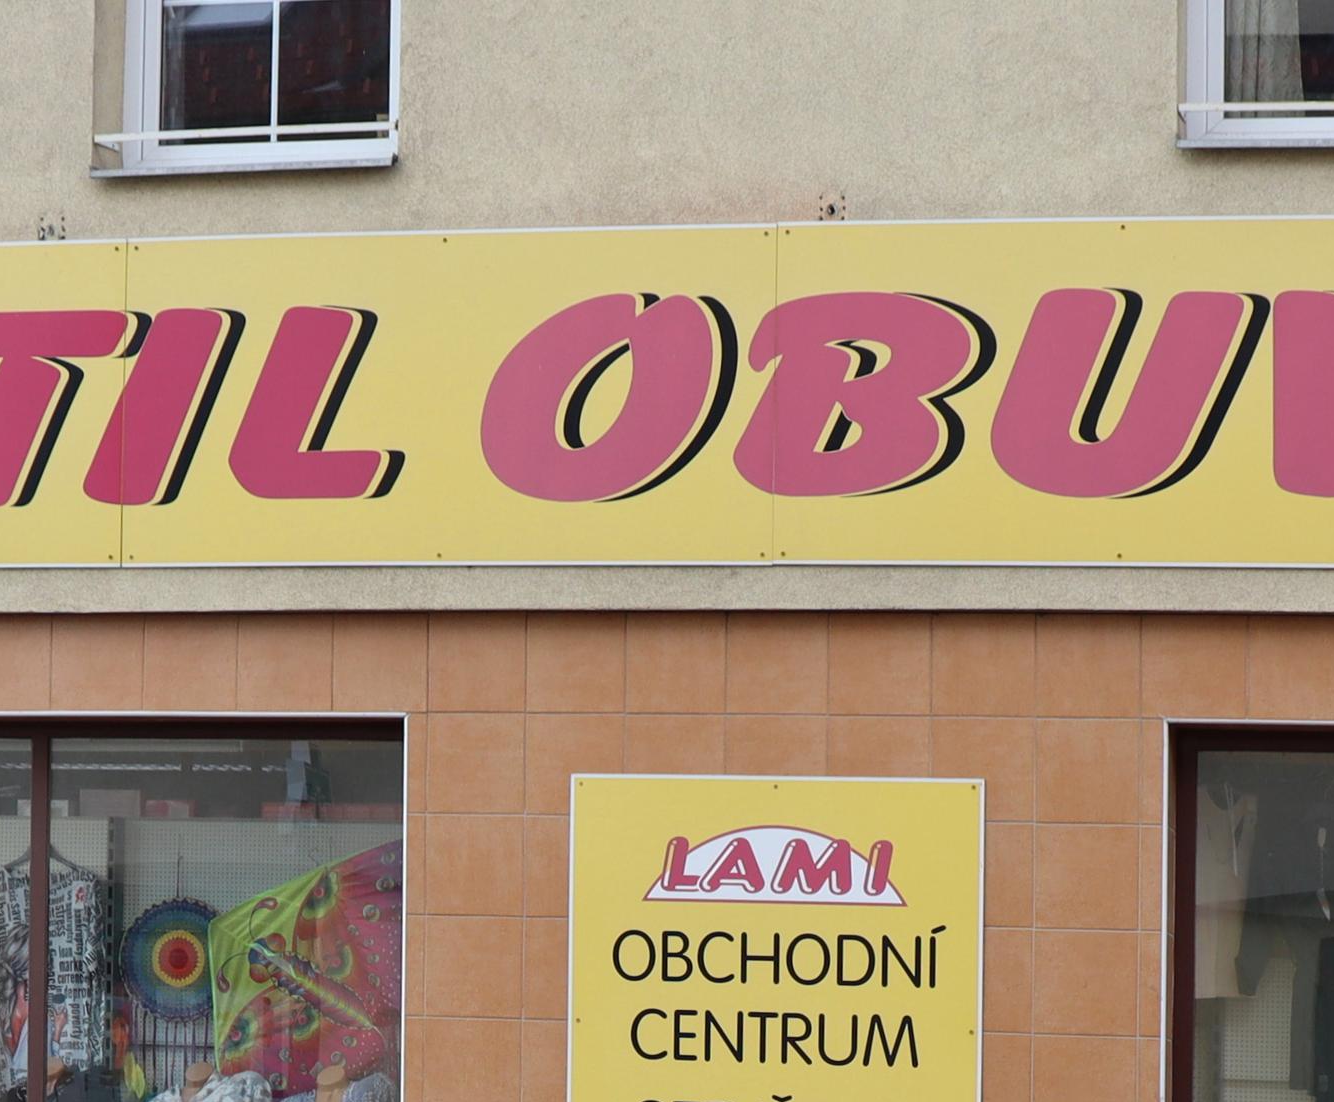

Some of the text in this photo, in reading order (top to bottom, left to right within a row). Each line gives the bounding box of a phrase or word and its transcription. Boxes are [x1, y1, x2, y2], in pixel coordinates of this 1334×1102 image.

[661, 836, 894, 896] LAMI
[58, 958, 83, 973] marke
[612, 925, 946, 988] OBCHODNÍ
[630, 1008, 919, 1068] CENTRUM
